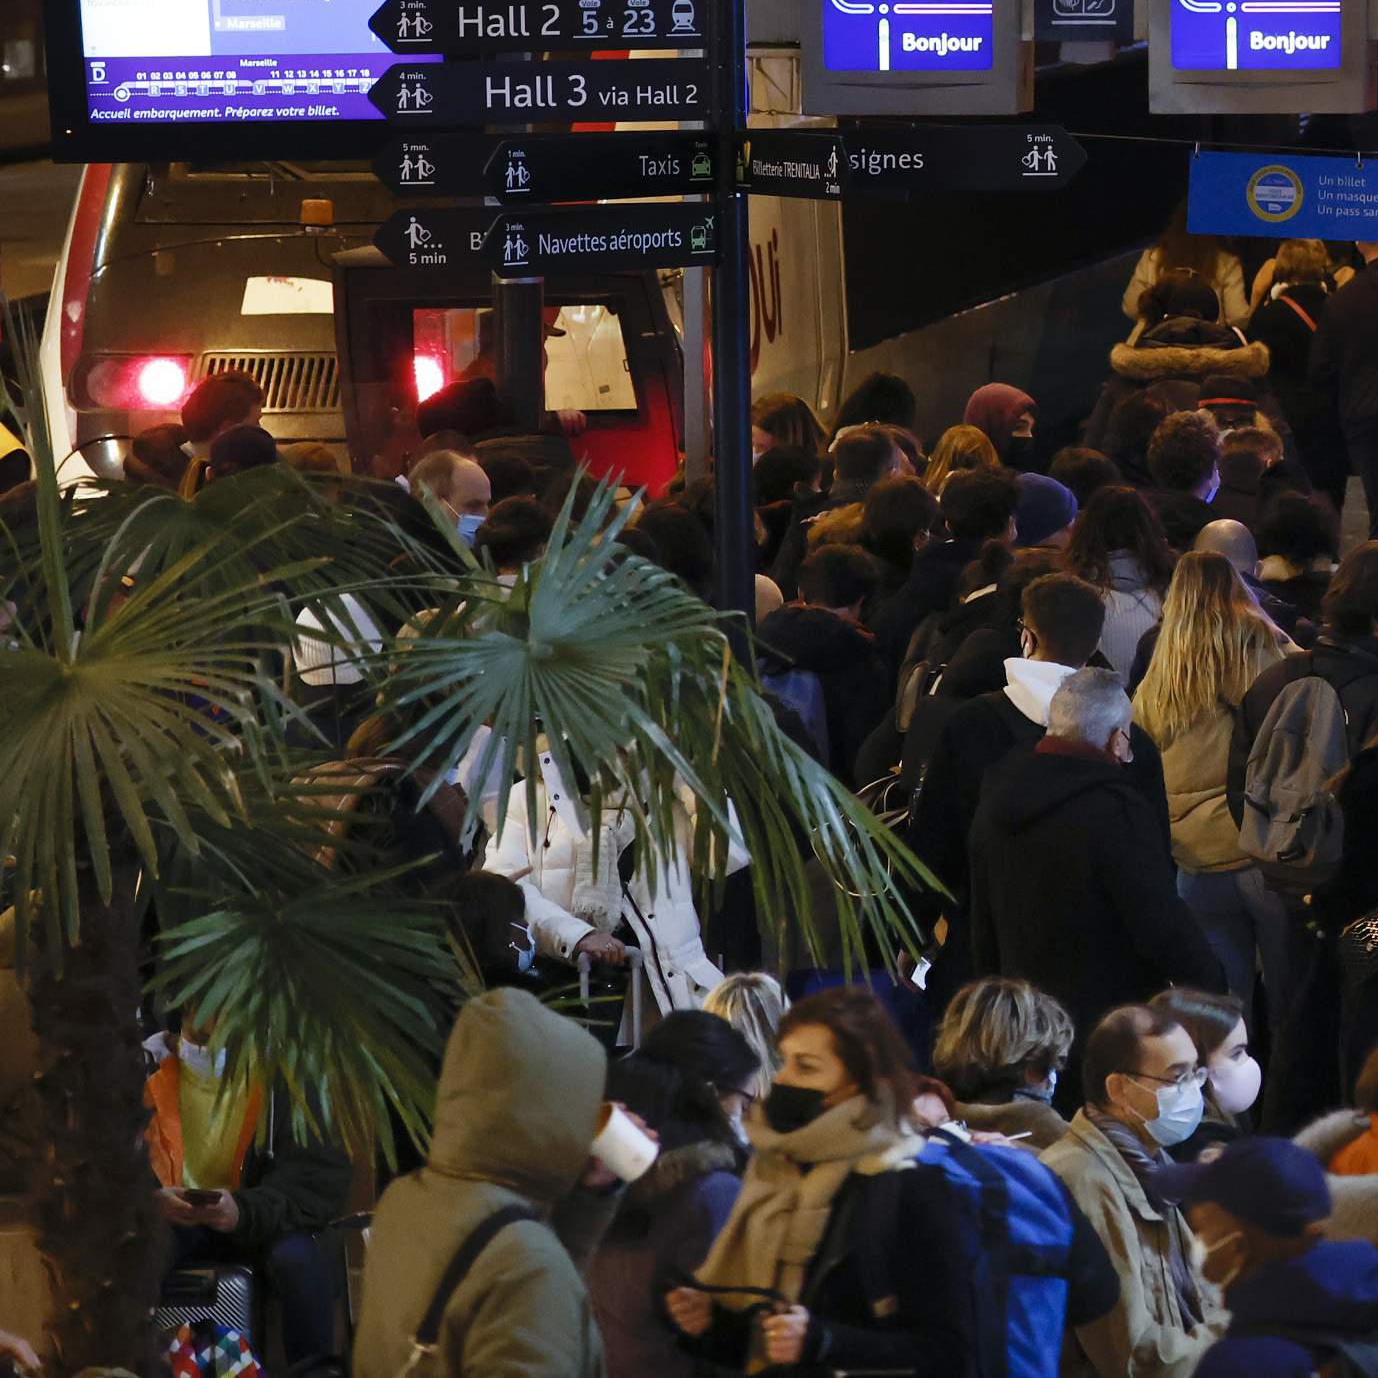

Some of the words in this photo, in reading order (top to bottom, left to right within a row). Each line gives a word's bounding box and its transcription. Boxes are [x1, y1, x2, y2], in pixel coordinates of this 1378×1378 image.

[226, 18, 282, 29] Marseille
[458, 5, 530, 37] Hall
[541, 5, 561, 36] 2
[582, 11, 599, 35] 5
[606, 17, 614, 29] à
[623, 9, 656, 34] 23
[902, 31, 983, 56] Bonjour
[1250, 29, 1330, 54] Bonjour
[485, 75, 556, 108] Hall
[567, 74, 587, 107] 3
[598, 87, 628, 105] via
[636, 85, 679, 105] Hall
[685, 84, 698, 104] 2
[91, 108, 130, 119] Accueil
[133, 108, 222, 120] embarquement.
[225, 106, 273, 119] Préparez
[276, 108, 302, 117] votre
[305, 106, 339, 116] billet.
[639, 154, 680, 176] Taxis
[753, 159, 783, 177] Billetterie
[783, 162, 821, 180] TRENITALIA
[1319, 176, 1334, 186] Un
[1337, 176, 1365, 187] billet
[1318, 190, 1334, 200] Un
[1336, 192, 1378, 203] masque
[1317, 204, 1333, 215] Un
[1335, 207, 1361, 218] pass
[539, 230, 607, 254] Navettes
[610, 227, 682, 254] aéroports
[409, 253, 418, 264] 5
[421, 252, 447, 264] min
